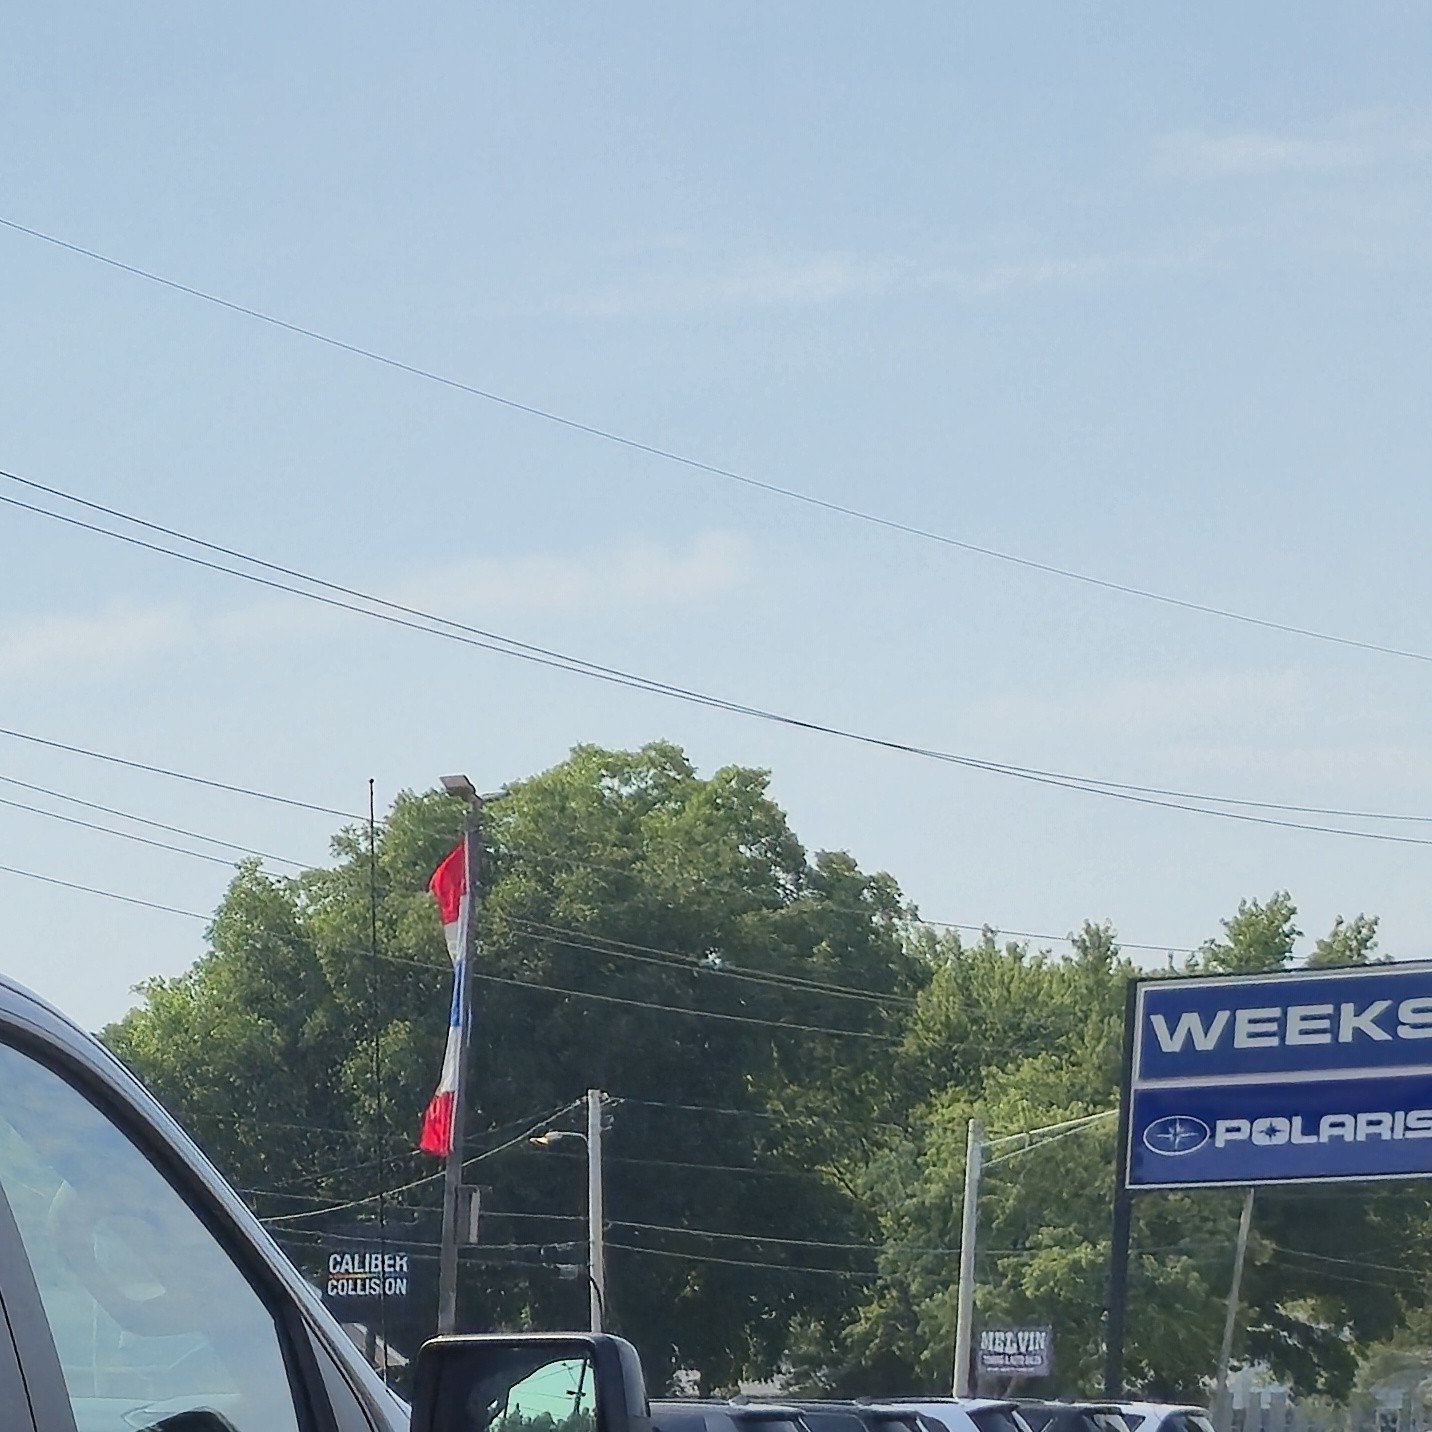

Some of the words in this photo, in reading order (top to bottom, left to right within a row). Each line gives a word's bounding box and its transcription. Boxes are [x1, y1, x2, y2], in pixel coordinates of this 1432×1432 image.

[1149, 996, 1432, 1053] WEEKS
[1214, 1109, 1432, 1148] POLARIS
[328, 1252, 409, 1274] CALIBER
[327, 1278, 407, 1297] COLLISION
